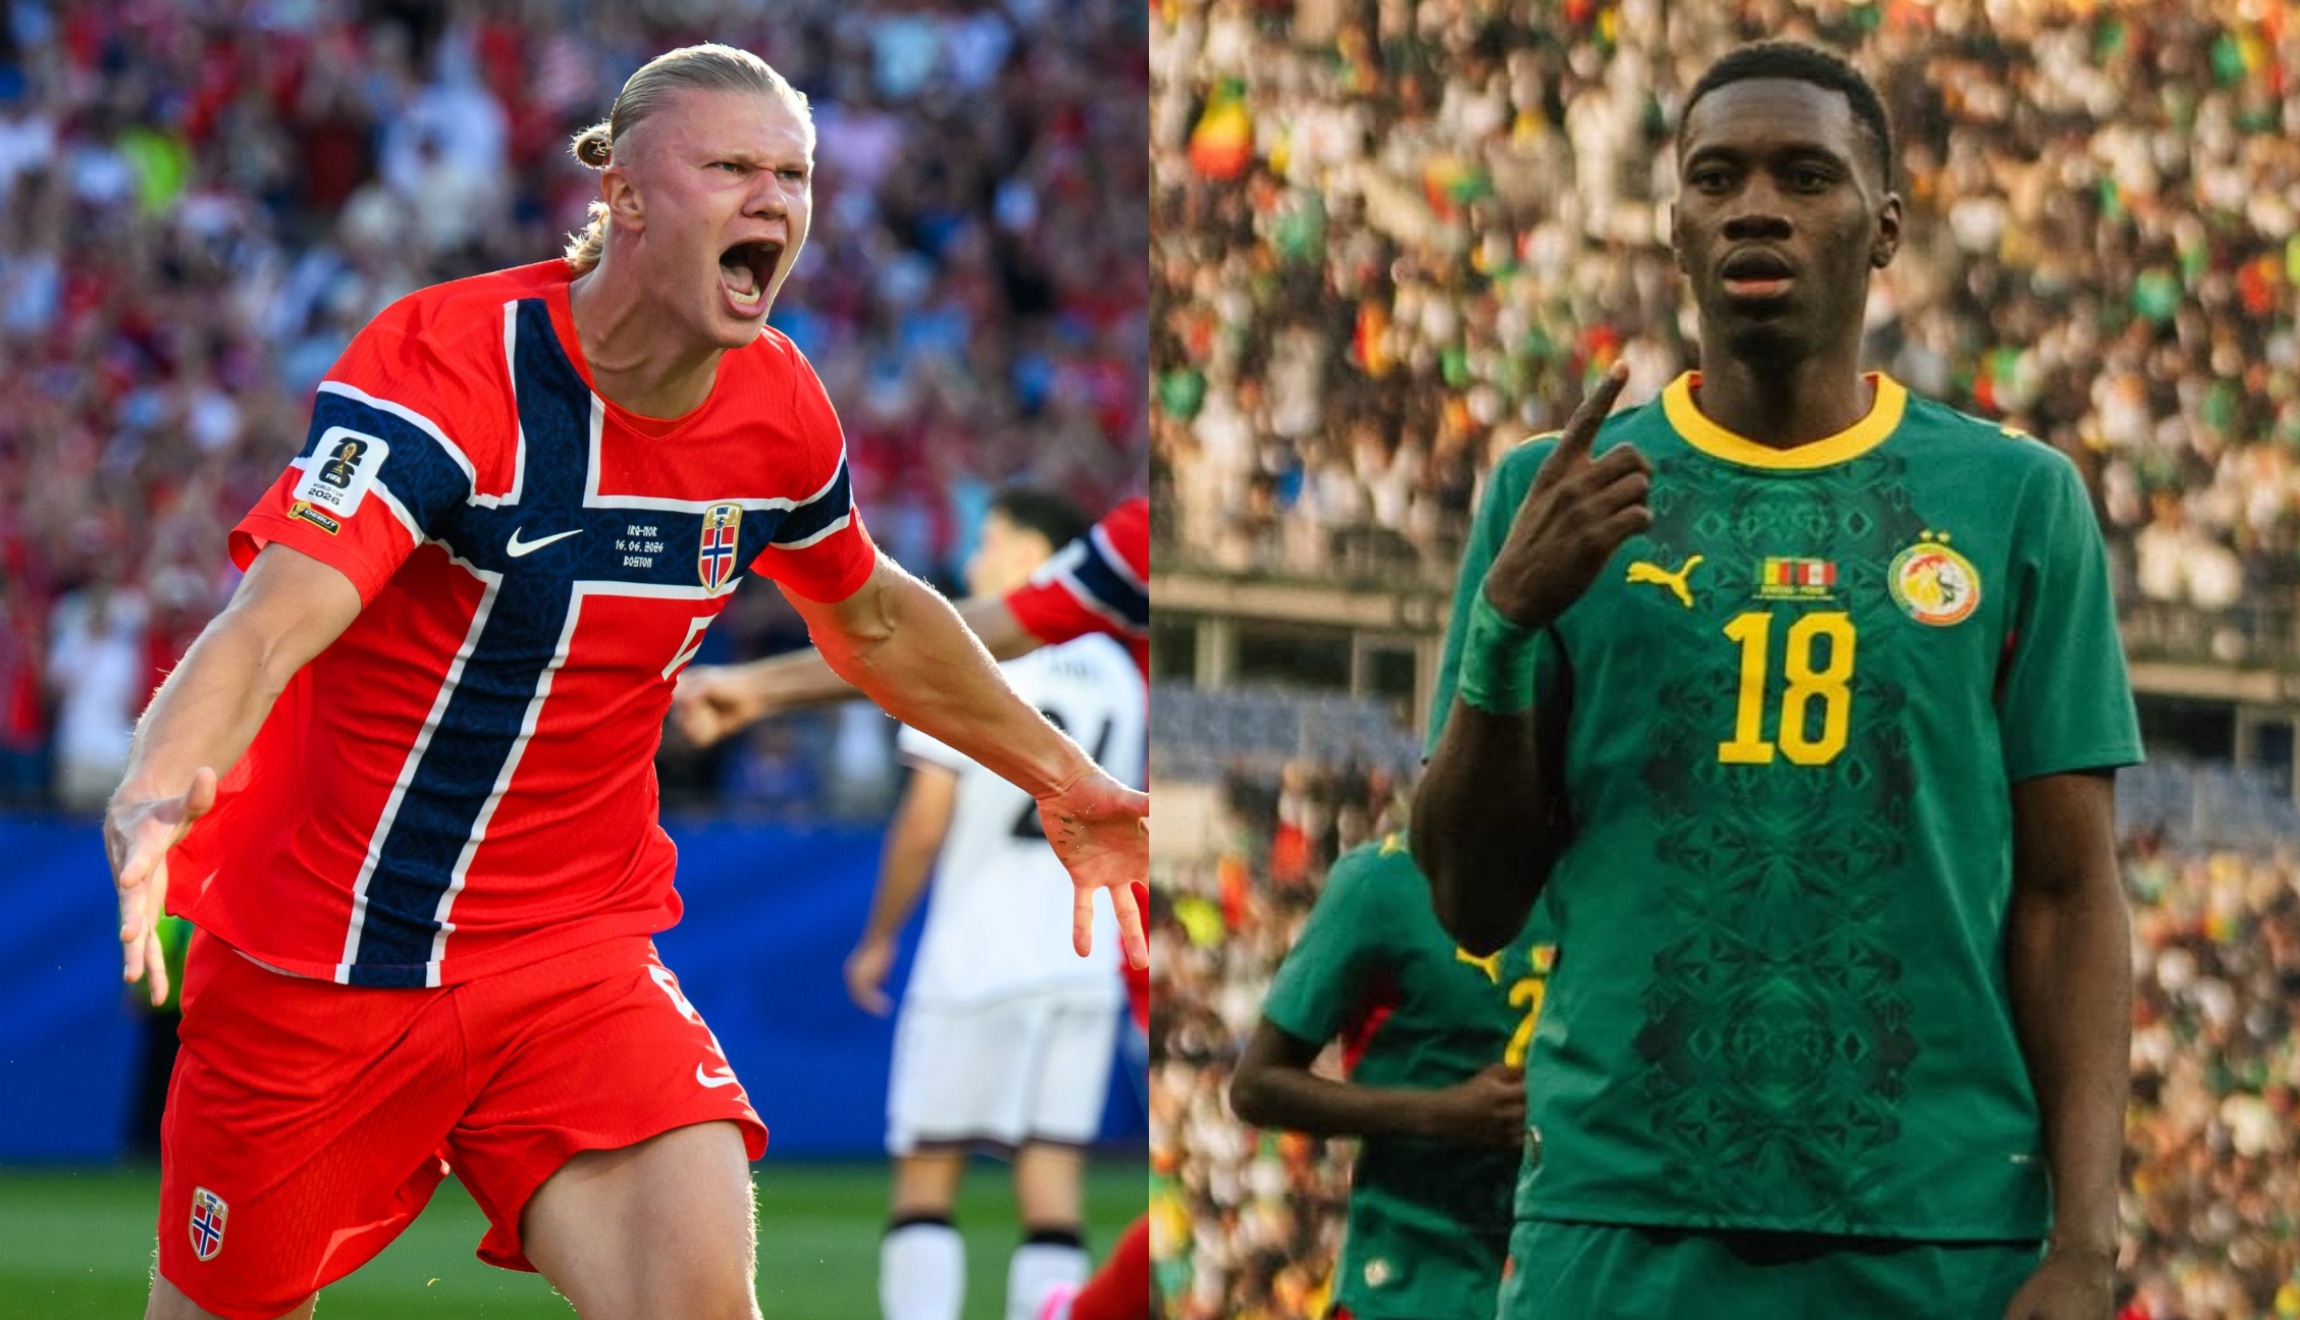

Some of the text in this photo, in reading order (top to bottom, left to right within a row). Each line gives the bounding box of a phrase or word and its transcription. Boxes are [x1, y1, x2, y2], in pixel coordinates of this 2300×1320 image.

[325, 472, 341, 484] FIFA
[313, 483, 332, 492] WORLD
[308, 487, 341, 506] 2026
[304, 509, 337, 527] DEBUT
[623, 555, 653, 568] BOSTON
[1718, 611, 1857, 765] 18
